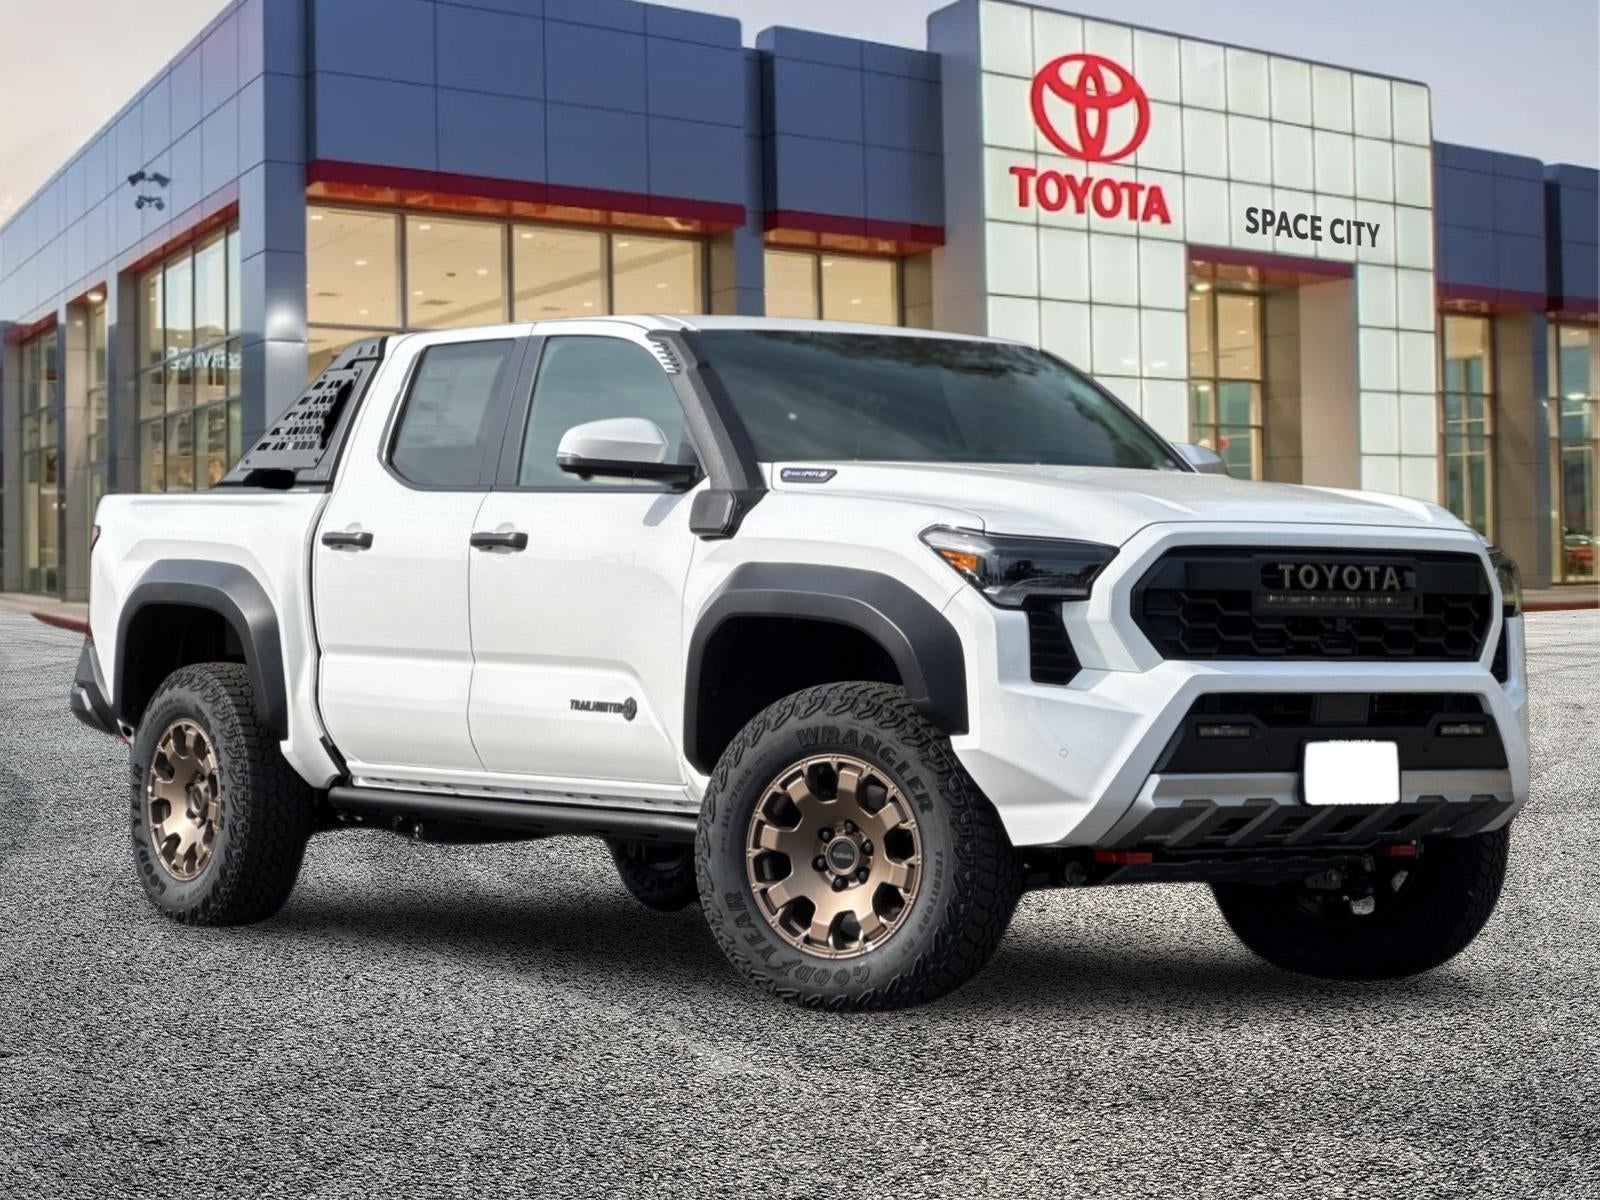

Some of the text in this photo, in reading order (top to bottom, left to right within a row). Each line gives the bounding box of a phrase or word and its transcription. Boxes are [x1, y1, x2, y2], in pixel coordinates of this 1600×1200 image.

[1009, 166, 1171, 225] TOYOTA
[1245, 207, 1381, 248] SPACE CITY
[1278, 564, 1401, 591] TOYOTA
[796, 726, 935, 814] WRANGLER
[725, 889, 871, 986] GOODYEAR
